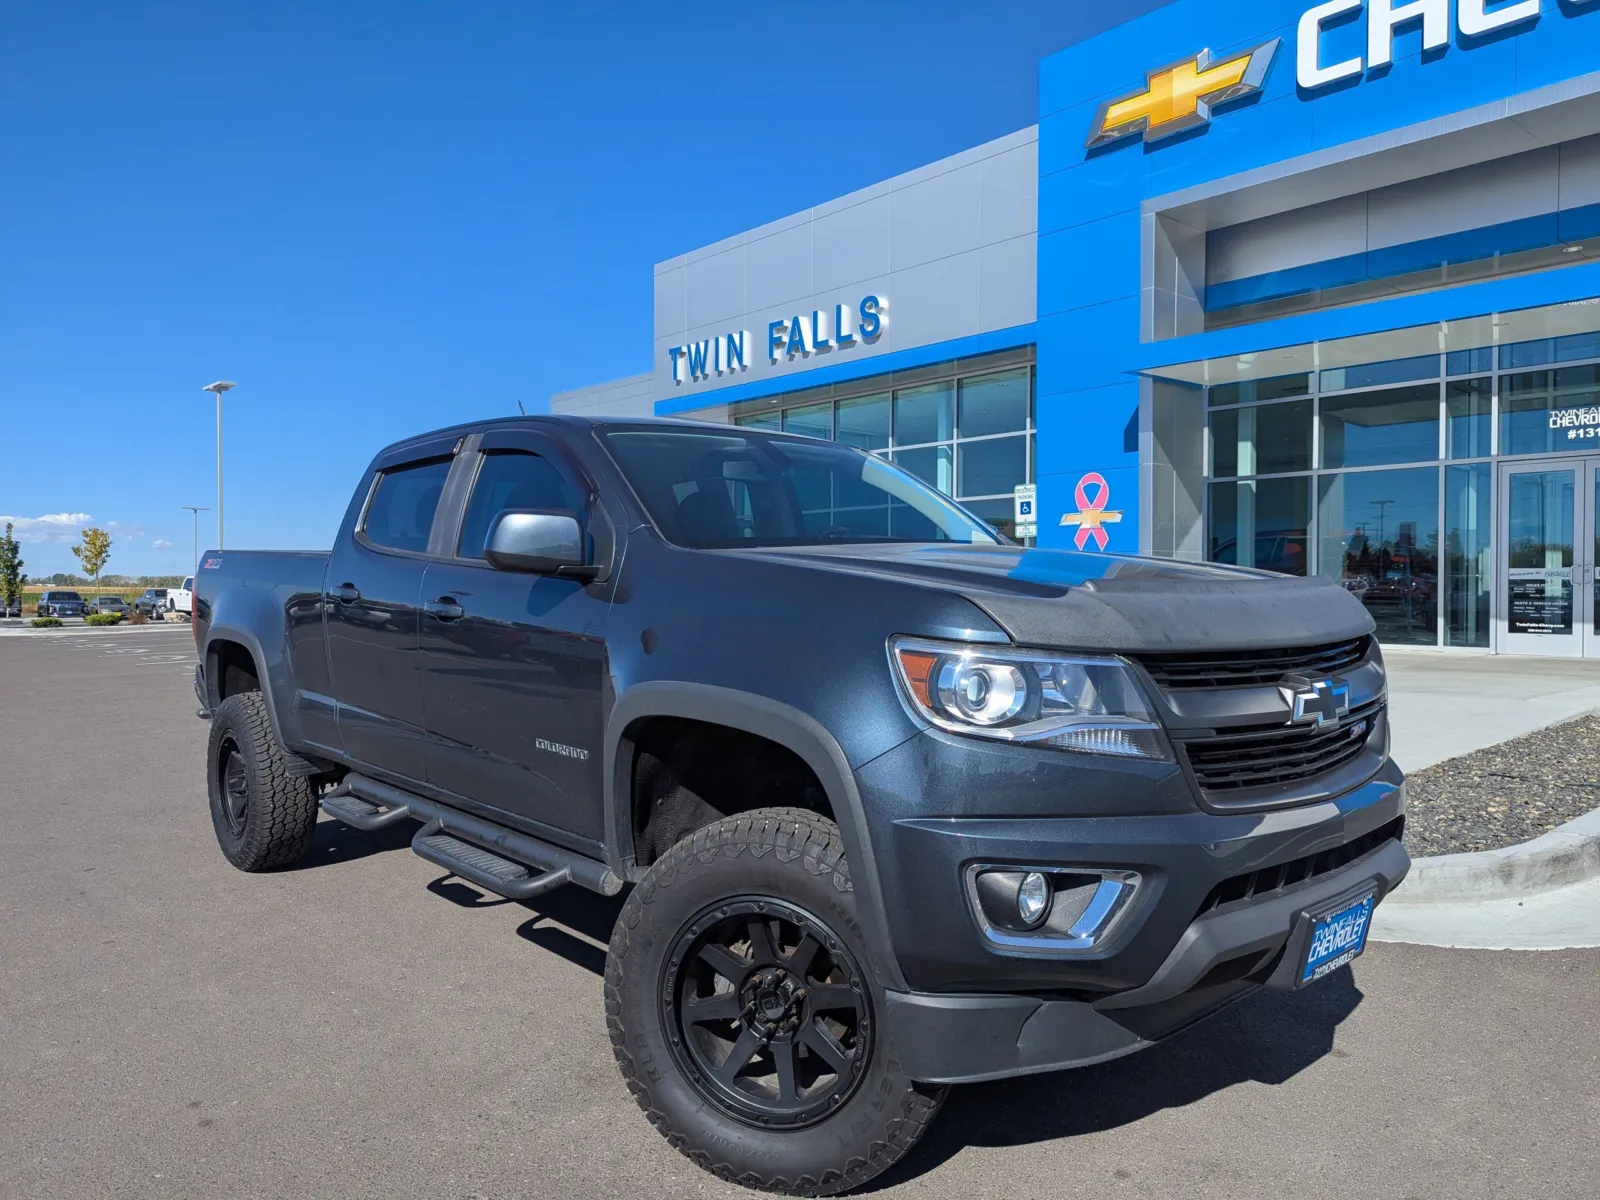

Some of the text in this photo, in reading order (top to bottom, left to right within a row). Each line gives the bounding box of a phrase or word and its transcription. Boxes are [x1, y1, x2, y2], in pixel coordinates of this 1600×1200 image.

[1297, 0, 1600, 88] CH
[669, 295, 884, 382] TWIN FALLS
[535, 737, 589, 760] COLORADO
[1307, 917, 1366, 963] CHEVROLET
